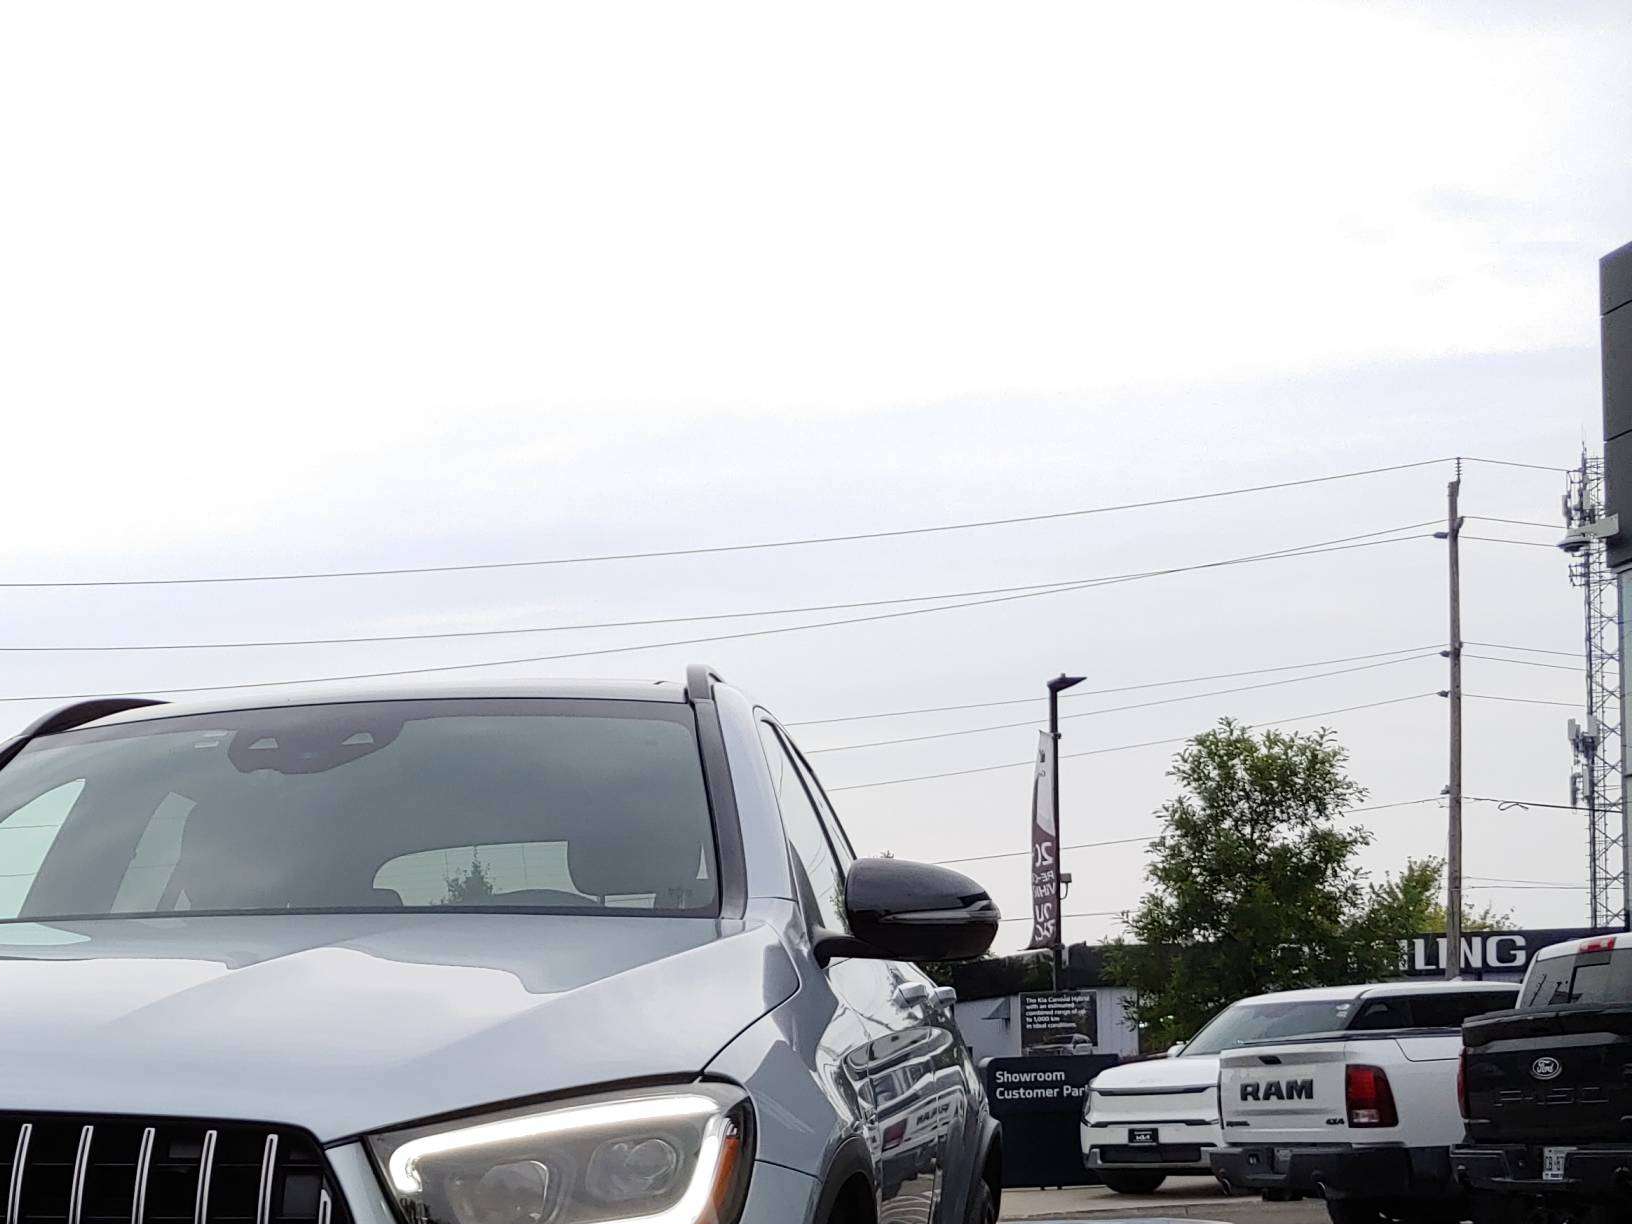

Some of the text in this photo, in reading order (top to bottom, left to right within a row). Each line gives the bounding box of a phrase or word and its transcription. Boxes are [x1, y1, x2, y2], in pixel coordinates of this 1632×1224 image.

[1535, 1059, 1556, 1074] Ford
[995, 1071, 1066, 1083] Showroom
[996, 1087, 1060, 1100] Customer
[1240, 1079, 1314, 1101] RAM
